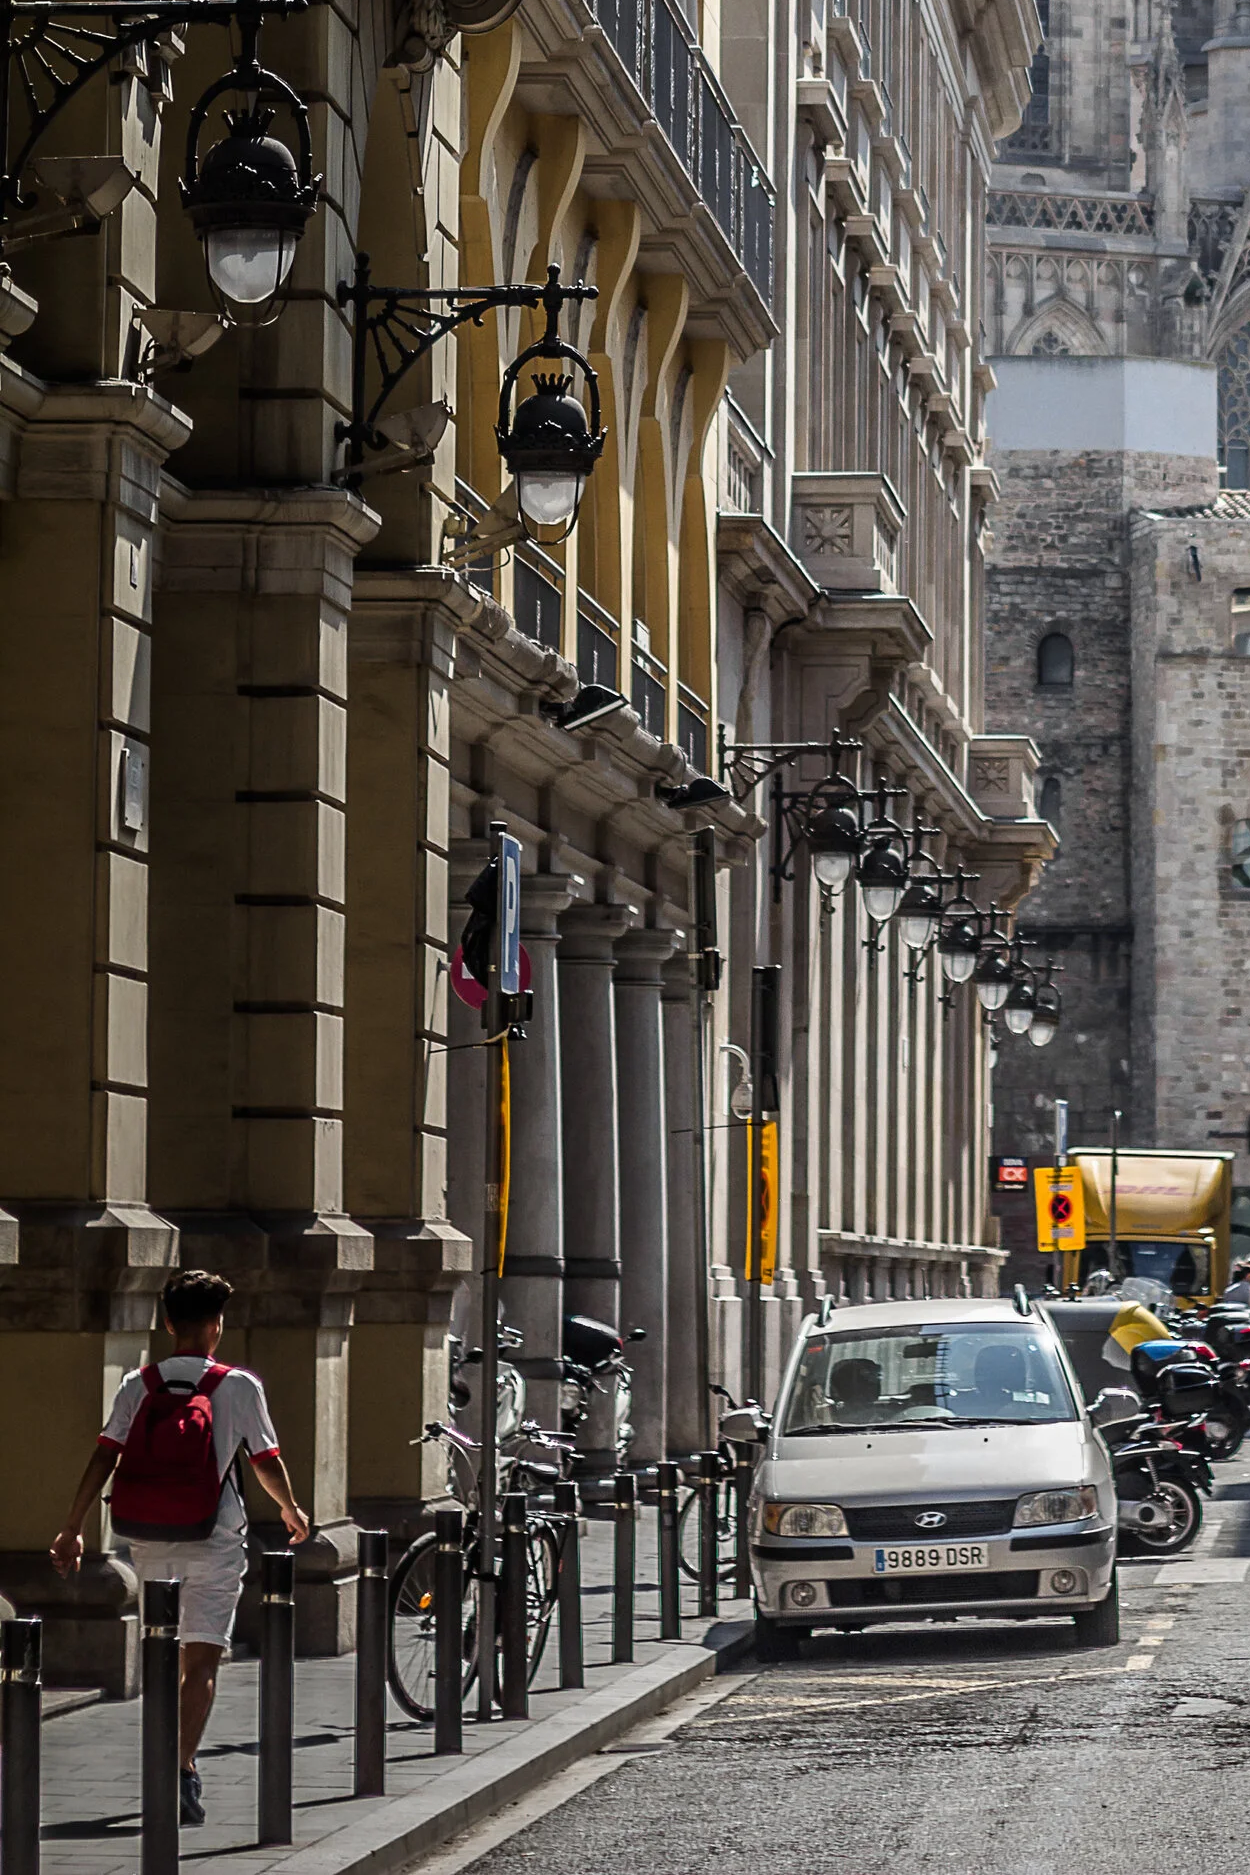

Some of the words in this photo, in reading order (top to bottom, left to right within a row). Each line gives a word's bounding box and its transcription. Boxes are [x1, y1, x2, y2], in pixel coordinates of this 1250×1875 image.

[506, 856, 517, 973] P
[887, 1549, 940, 1569] 9889
[946, 1546, 982, 1566] DSR
